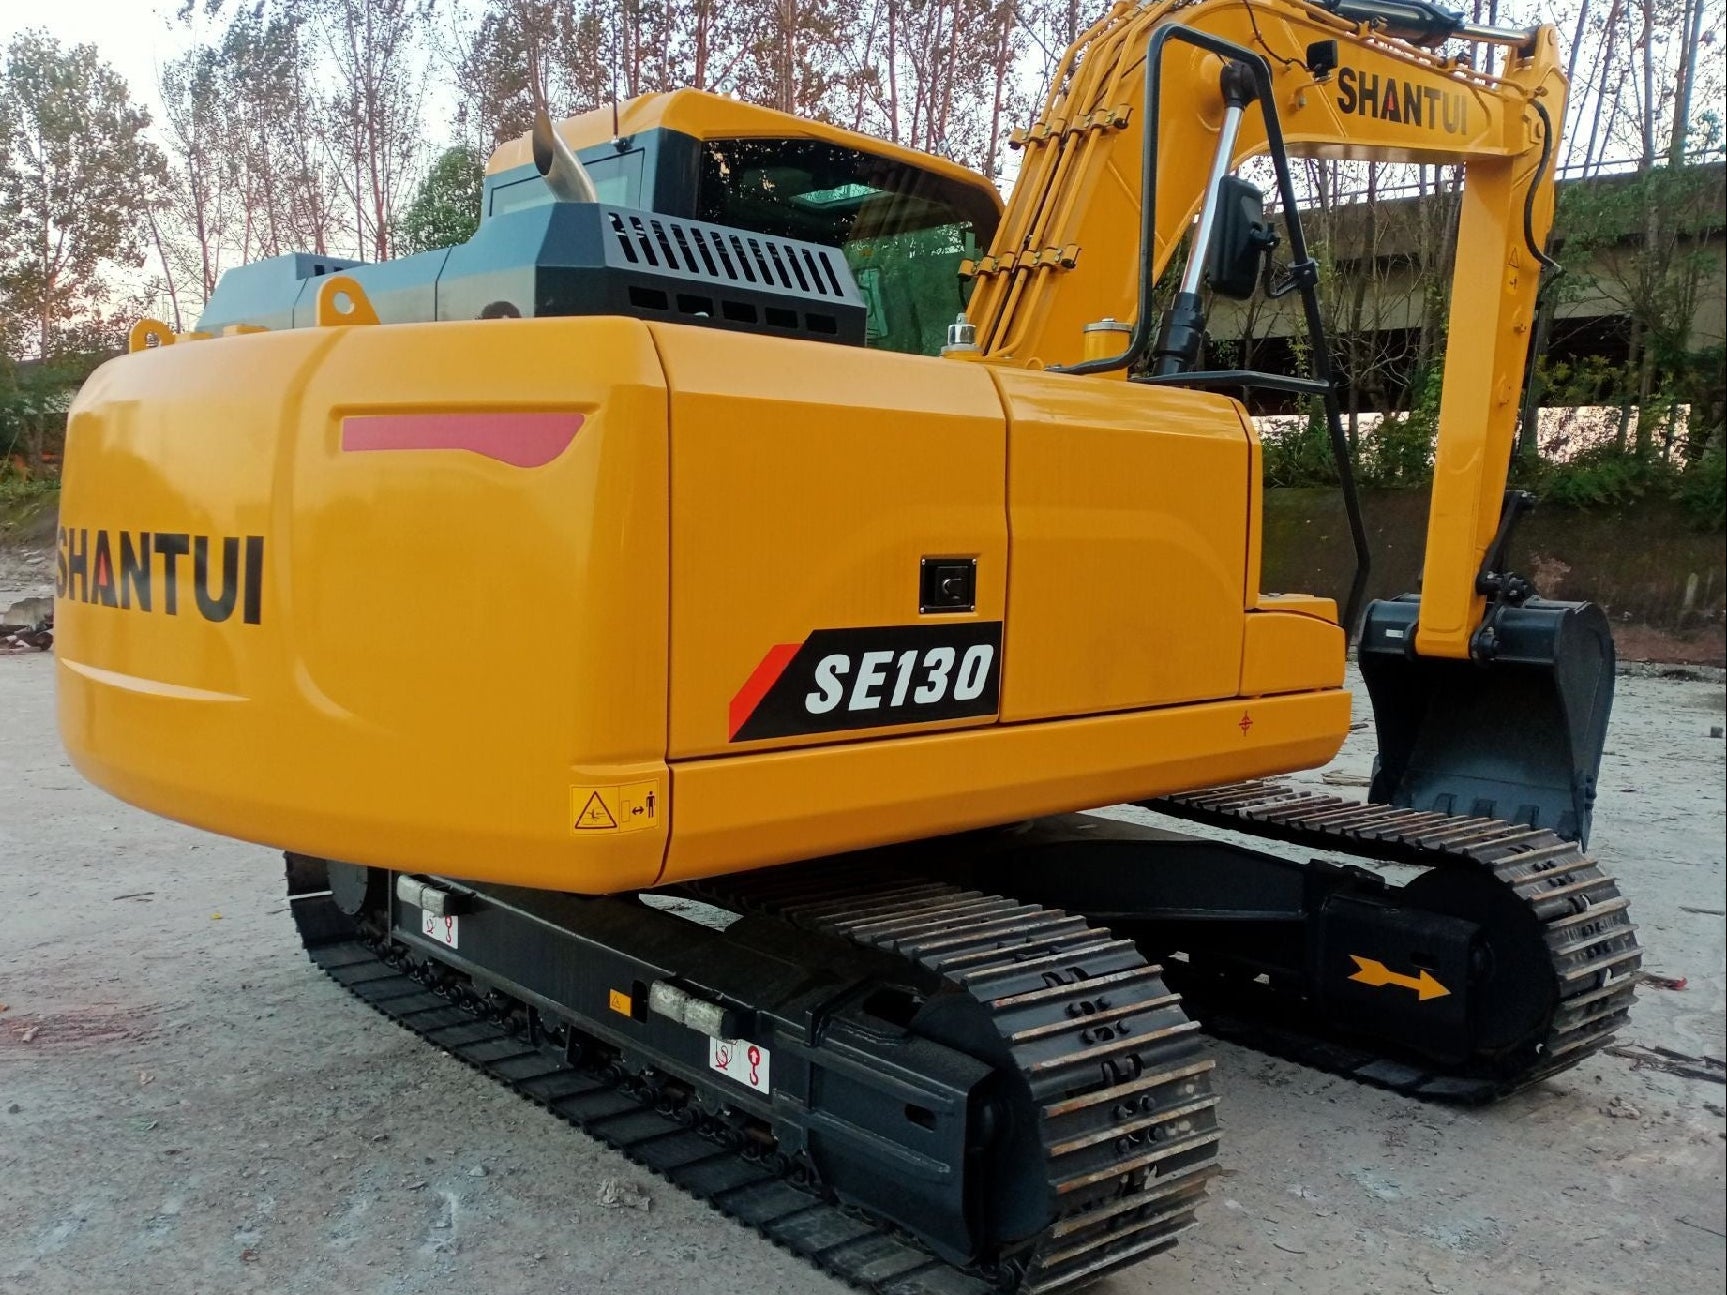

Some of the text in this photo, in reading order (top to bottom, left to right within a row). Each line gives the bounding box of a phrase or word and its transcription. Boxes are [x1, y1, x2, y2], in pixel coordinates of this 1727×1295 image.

[1337, 67, 1467, 135] SHANTUI
[55, 526, 264, 625] SHANTUI
[804, 644, 994, 715] SE130
